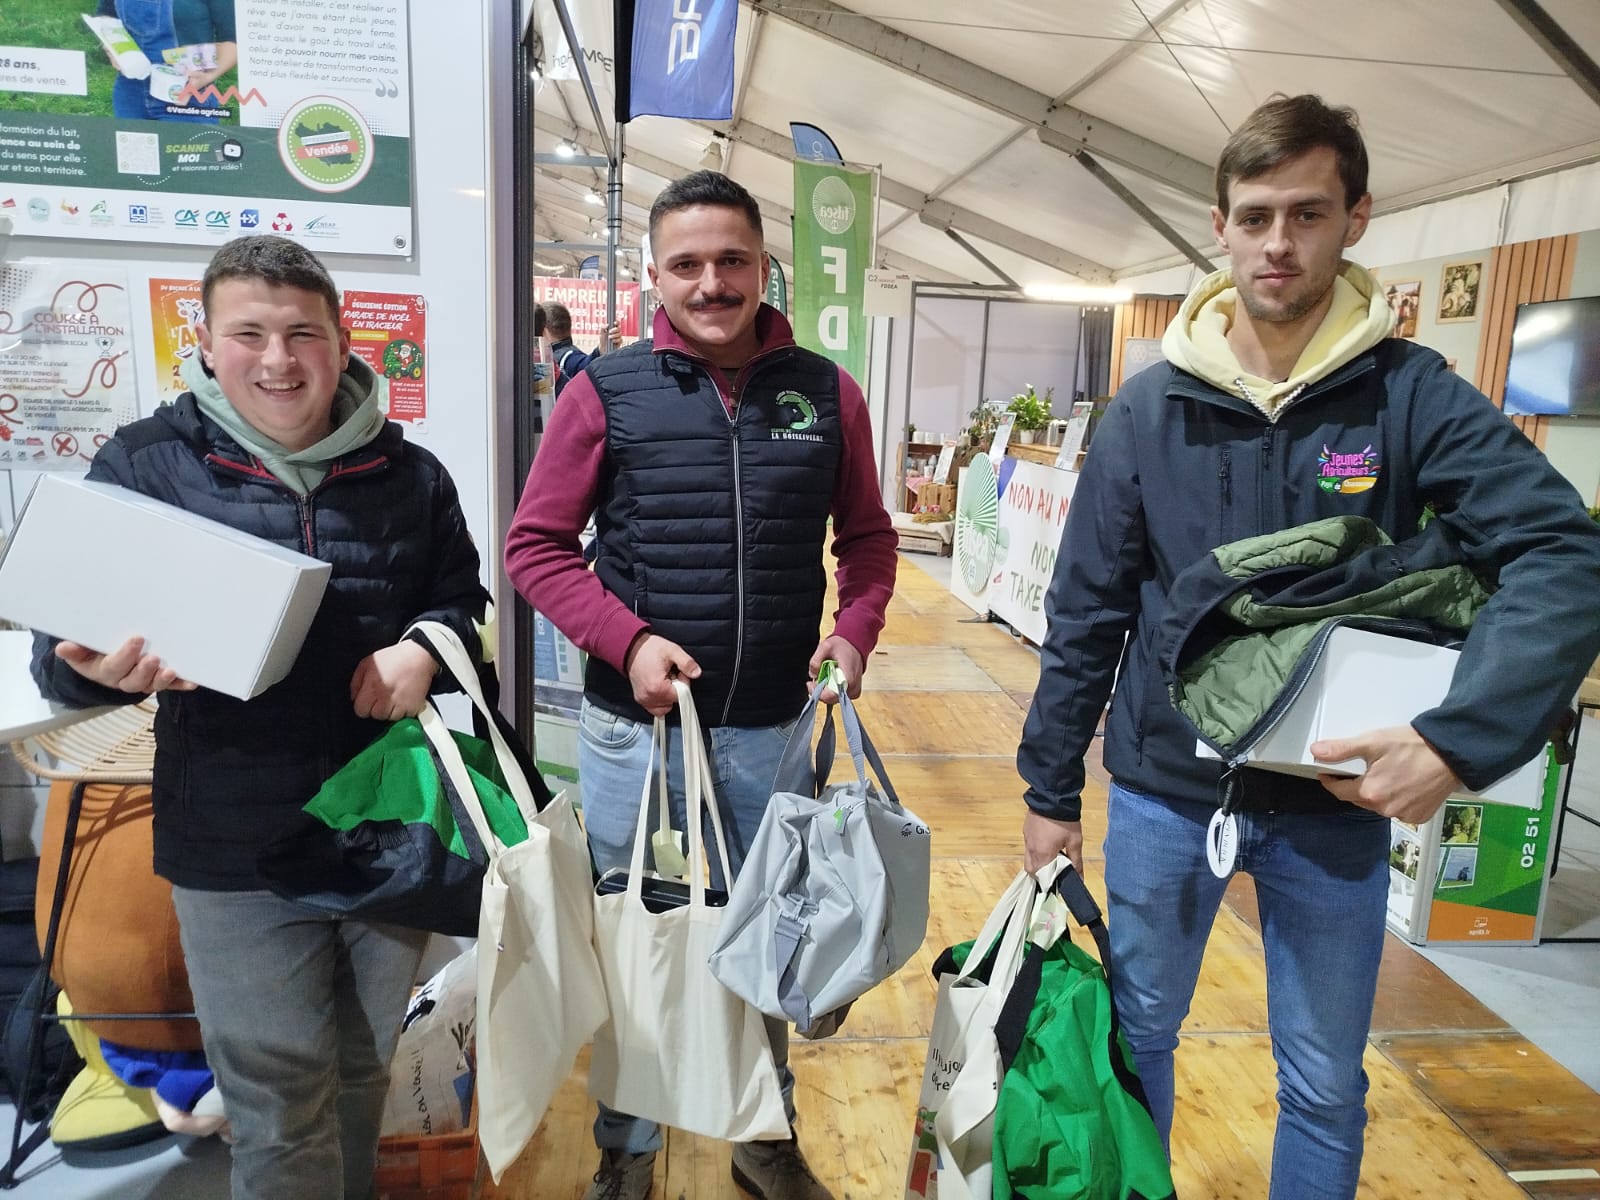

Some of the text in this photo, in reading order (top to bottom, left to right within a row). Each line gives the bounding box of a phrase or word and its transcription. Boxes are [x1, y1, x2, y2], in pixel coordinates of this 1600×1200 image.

[270, 11, 287, 19] que
[334, 27, 362, 36] propre
[248, 31, 271, 40] C'est
[333, 38, 344, 46] du
[348, 40, 374, 48] travail
[272, 46, 283, 54] de
[285, 48, 317, 57] pouvoir
[249, 57, 272, 66] Notre
[303, 60, 314, 69] de
[316, 62, 378, 72] transformation
[379, 67, 399, 75] nous
[20, 75, 33, 84] de
[250, 69, 268, 77] rend
[270, 71, 287, 79] plus
[289, 71, 319, 81] flexible
[200, 108, 231, 117] agricole
[46, 126, 60, 136] du
[27, 140, 42, 148] au
[43, 140, 65, 149] sein
[66, 140, 81, 150] de
[165, 144, 211, 153] SCANNE
[305, 143, 349, 157] Vendée
[1, 149, 14, 159] du
[16, 152, 38, 160] sens
[39, 154, 61, 163] pour
[63, 153, 81, 163] elle
[177, 153, 200, 163] MOI
[11, 164, 22, 172] et
[24, 165, 41, 173] son
[34, 312, 86, 325] COURSE
[343, 310, 376, 319] PARADE
[376, 312, 388, 320] DE
[34, 324, 124, 336] L'INSTALLATION
[352, 320, 403, 331] EN TRACTEUR
[771, 432, 780, 440] LA
[1330, 452, 1365, 467] Jeunes
[1008, 481, 1035, 515] NON
[1037, 488, 1054, 523] AU
[1010, 571, 1043, 613] TAXE
[1520, 817, 1541, 868] 02 51
